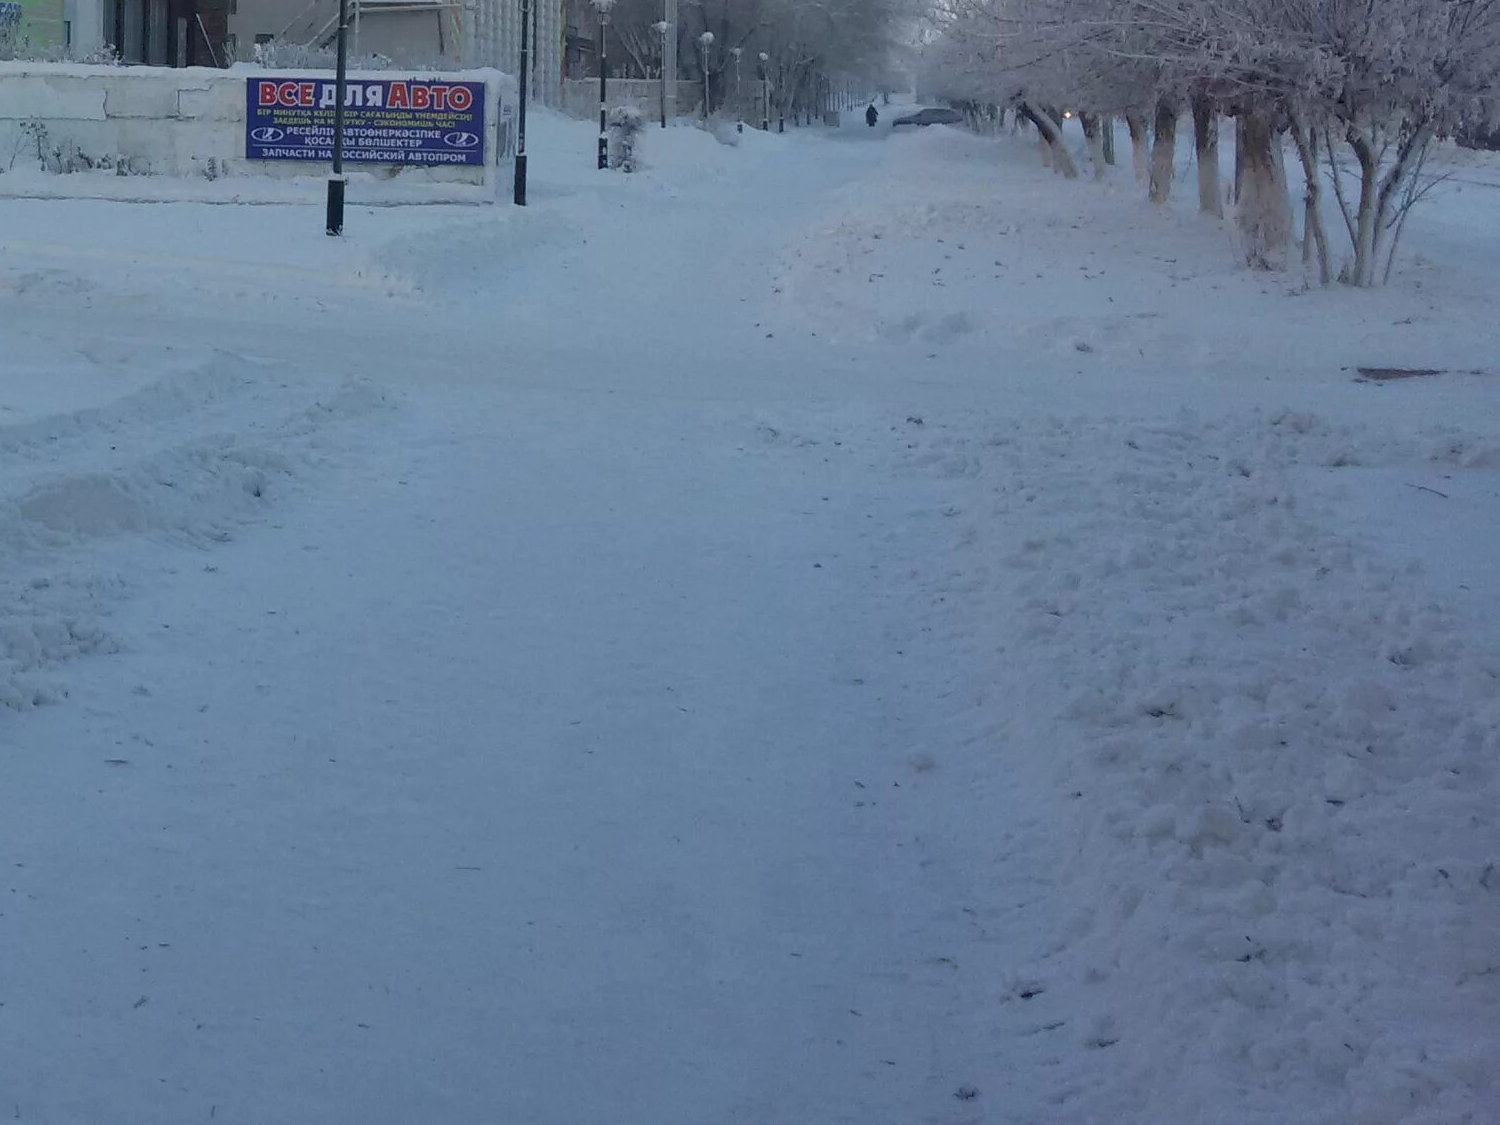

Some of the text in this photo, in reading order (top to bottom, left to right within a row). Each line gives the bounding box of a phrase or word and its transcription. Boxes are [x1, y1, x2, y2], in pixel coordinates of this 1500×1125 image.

[258, 82, 316, 106] ВСЕ
[319, 84, 383, 109] ДЛЯ
[358, 137, 423, 147] БӨЛШЕКТЕР
[262, 149, 467, 162] ЗАПЧАСТИ НА ОССИЙСКИЙ АВТОПРОМ
